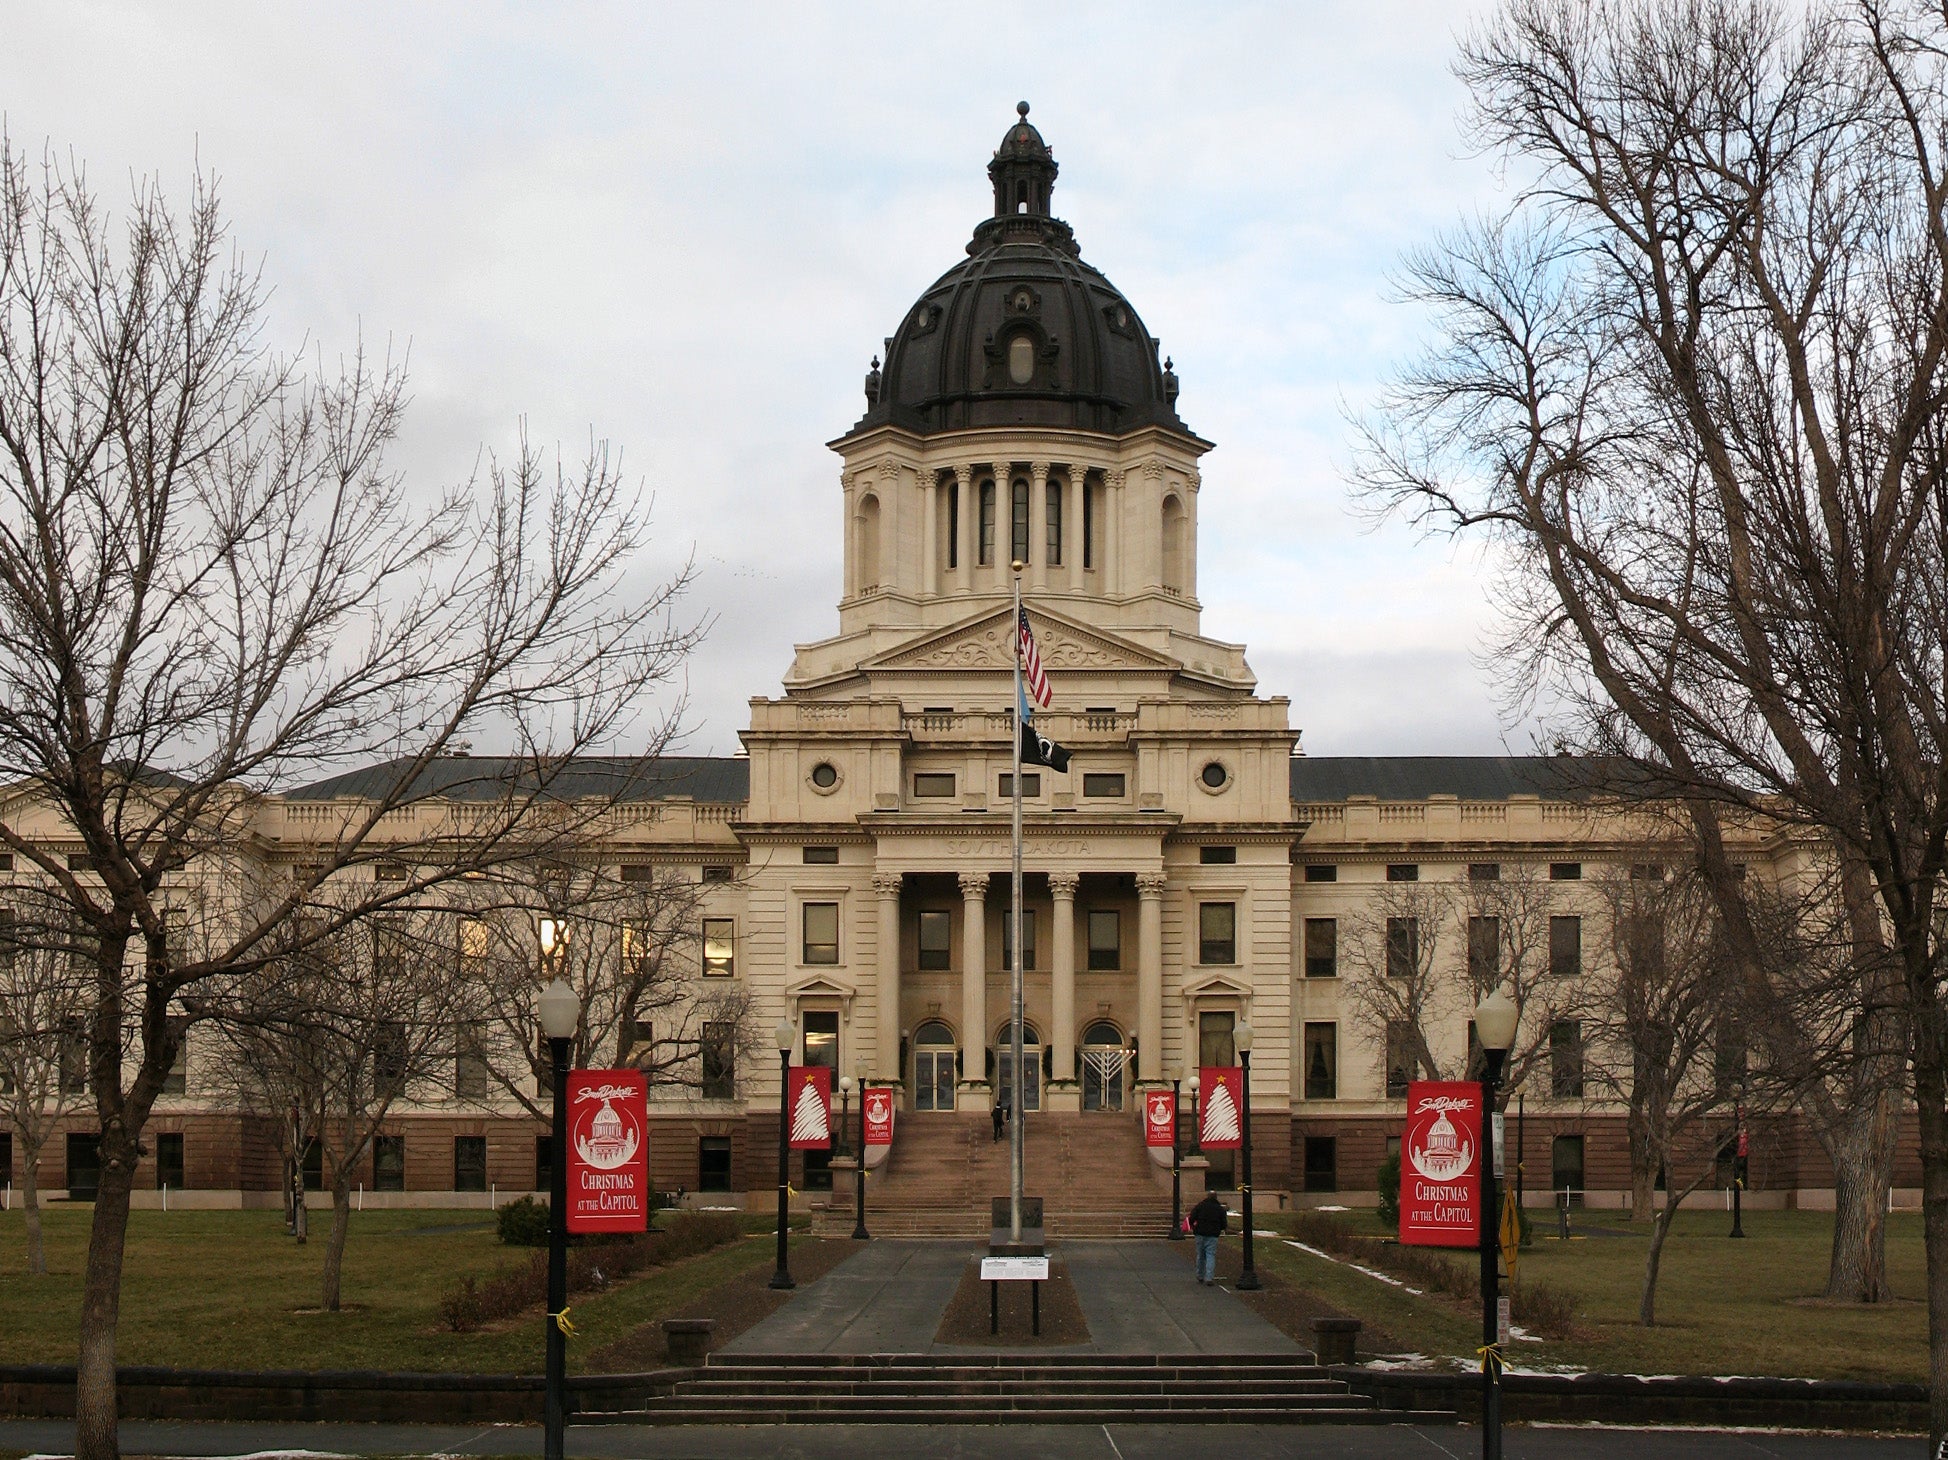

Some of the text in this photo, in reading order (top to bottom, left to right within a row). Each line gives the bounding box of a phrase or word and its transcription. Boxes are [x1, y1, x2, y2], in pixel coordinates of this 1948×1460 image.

[1020, 840, 1091, 855] DAKOTA
[581, 1170, 634, 1190] CHRISTMAS
[577, 1191, 639, 1211] AT THE CAPITOL
[1415, 1181, 1468, 1202] CHRISTMAS
[1411, 1202, 1473, 1223] AT THE CAPITOL
